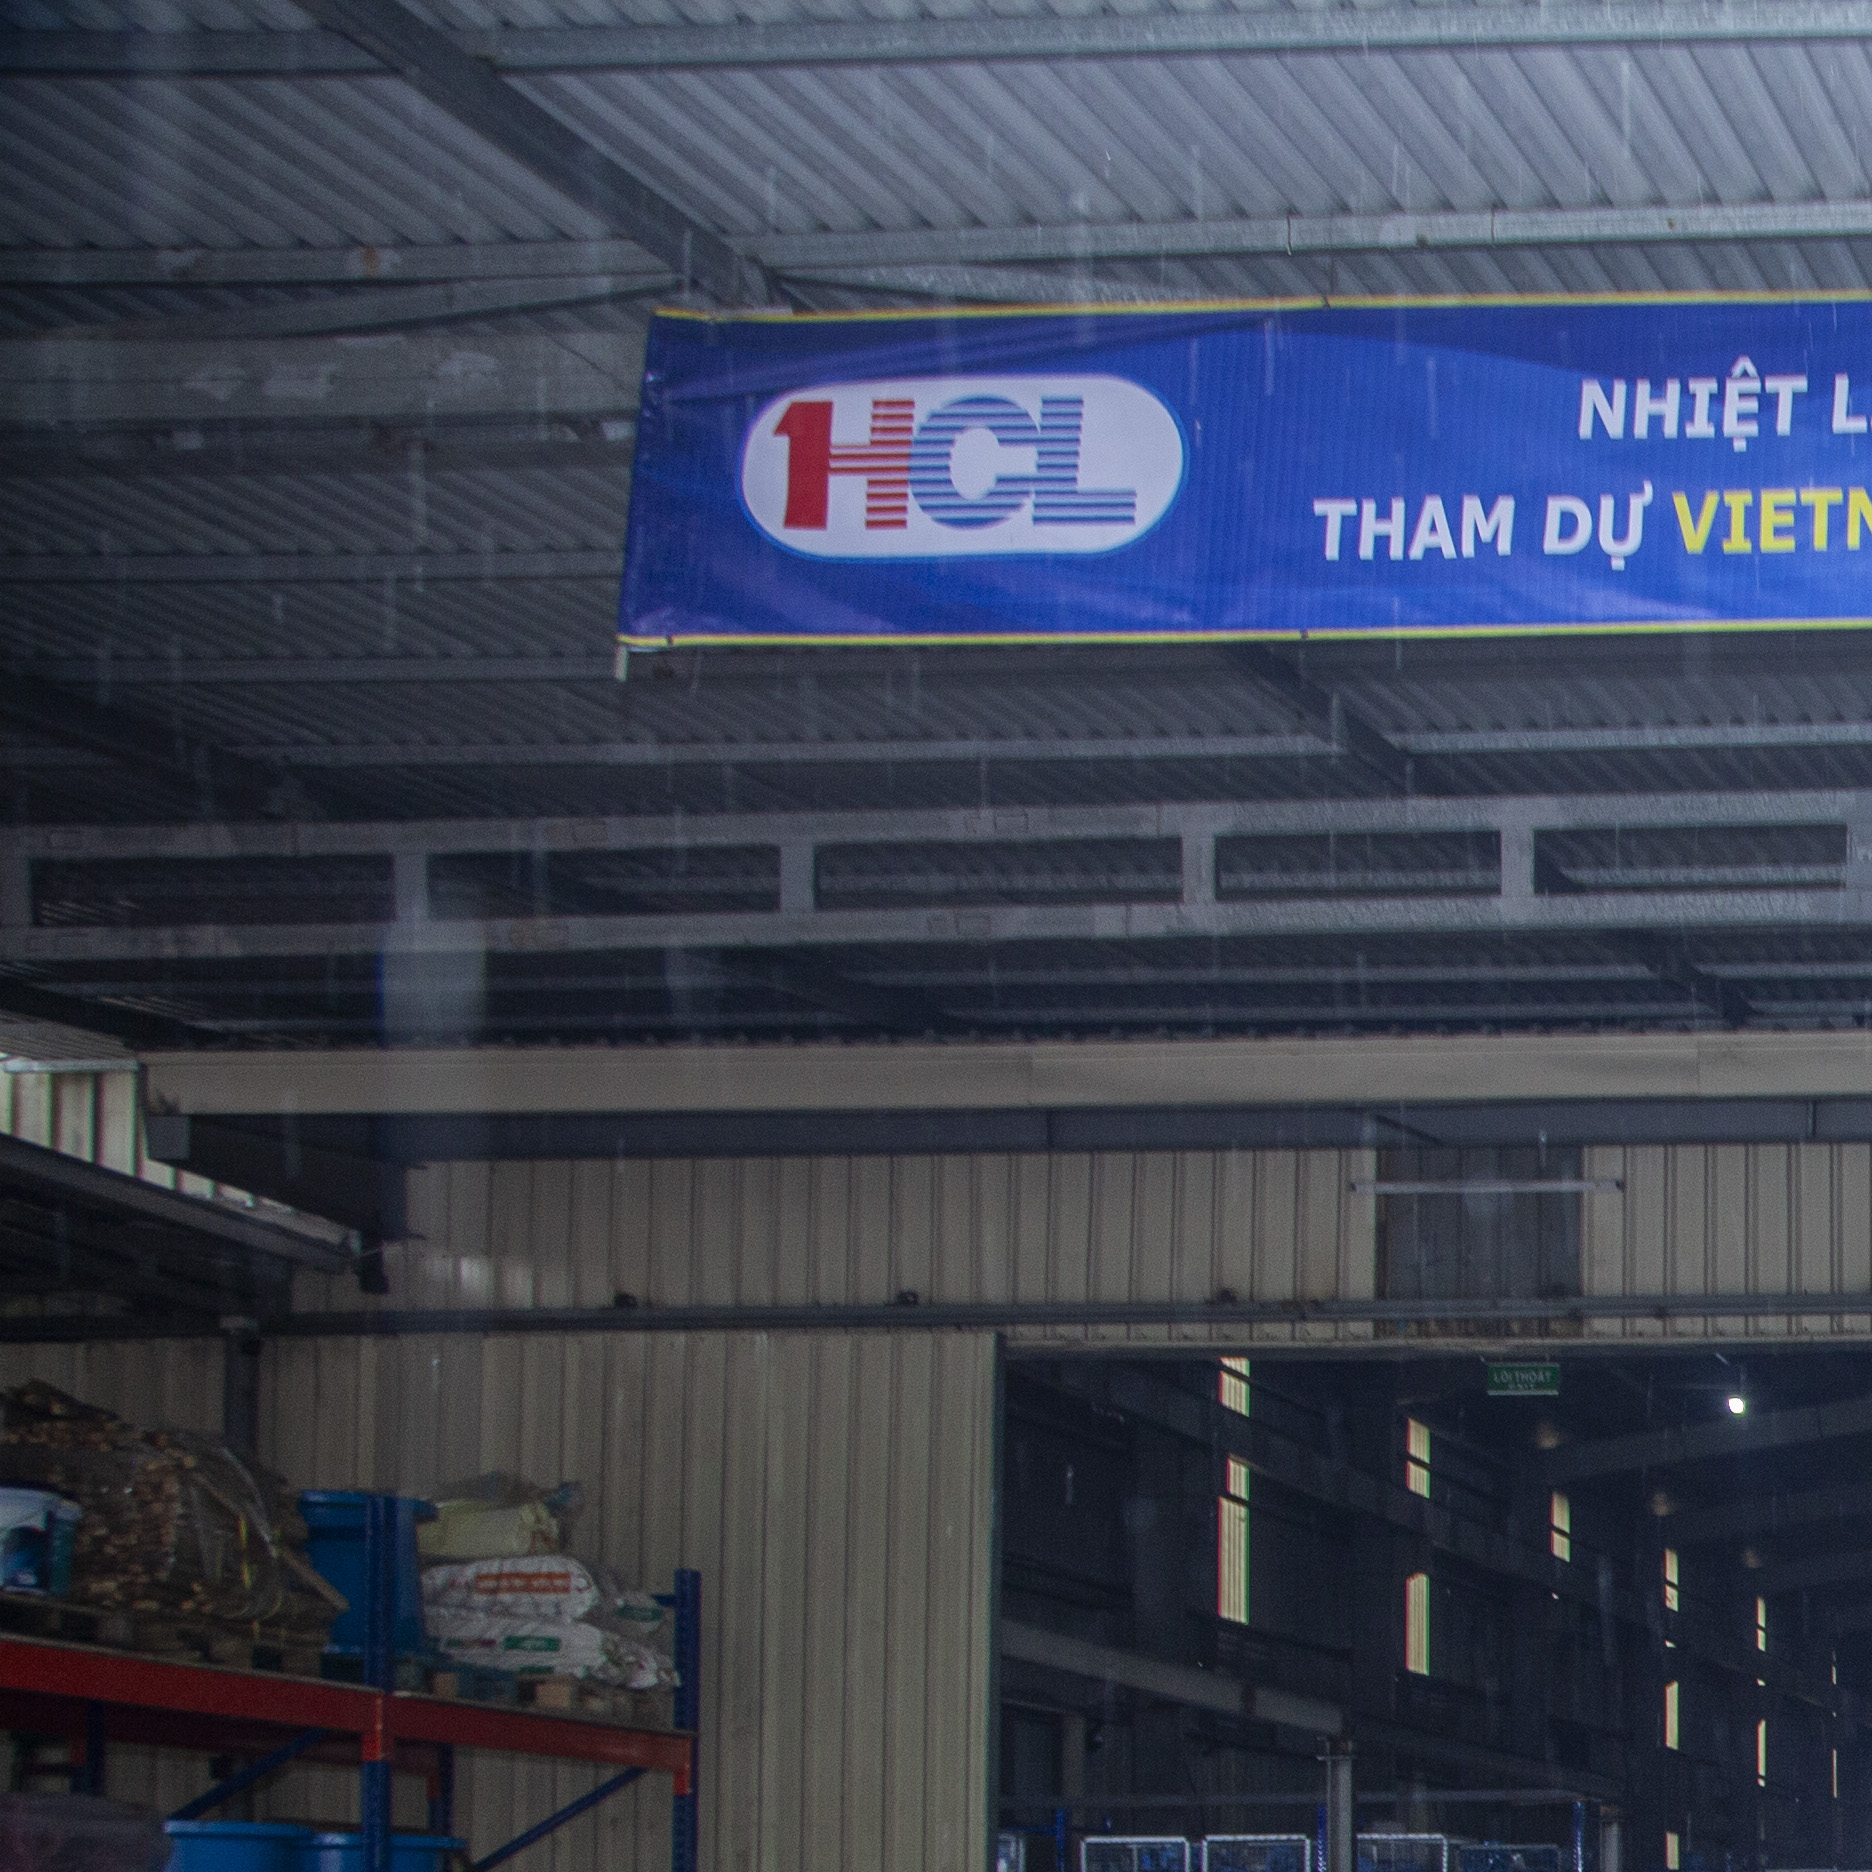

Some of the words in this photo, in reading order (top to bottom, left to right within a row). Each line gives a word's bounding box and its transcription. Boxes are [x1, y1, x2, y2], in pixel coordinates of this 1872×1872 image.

[1579, 355, 1807, 452] NHIỆT
[1314, 494, 1516, 561] THAM
[1543, 482, 1654, 570] DỰ
